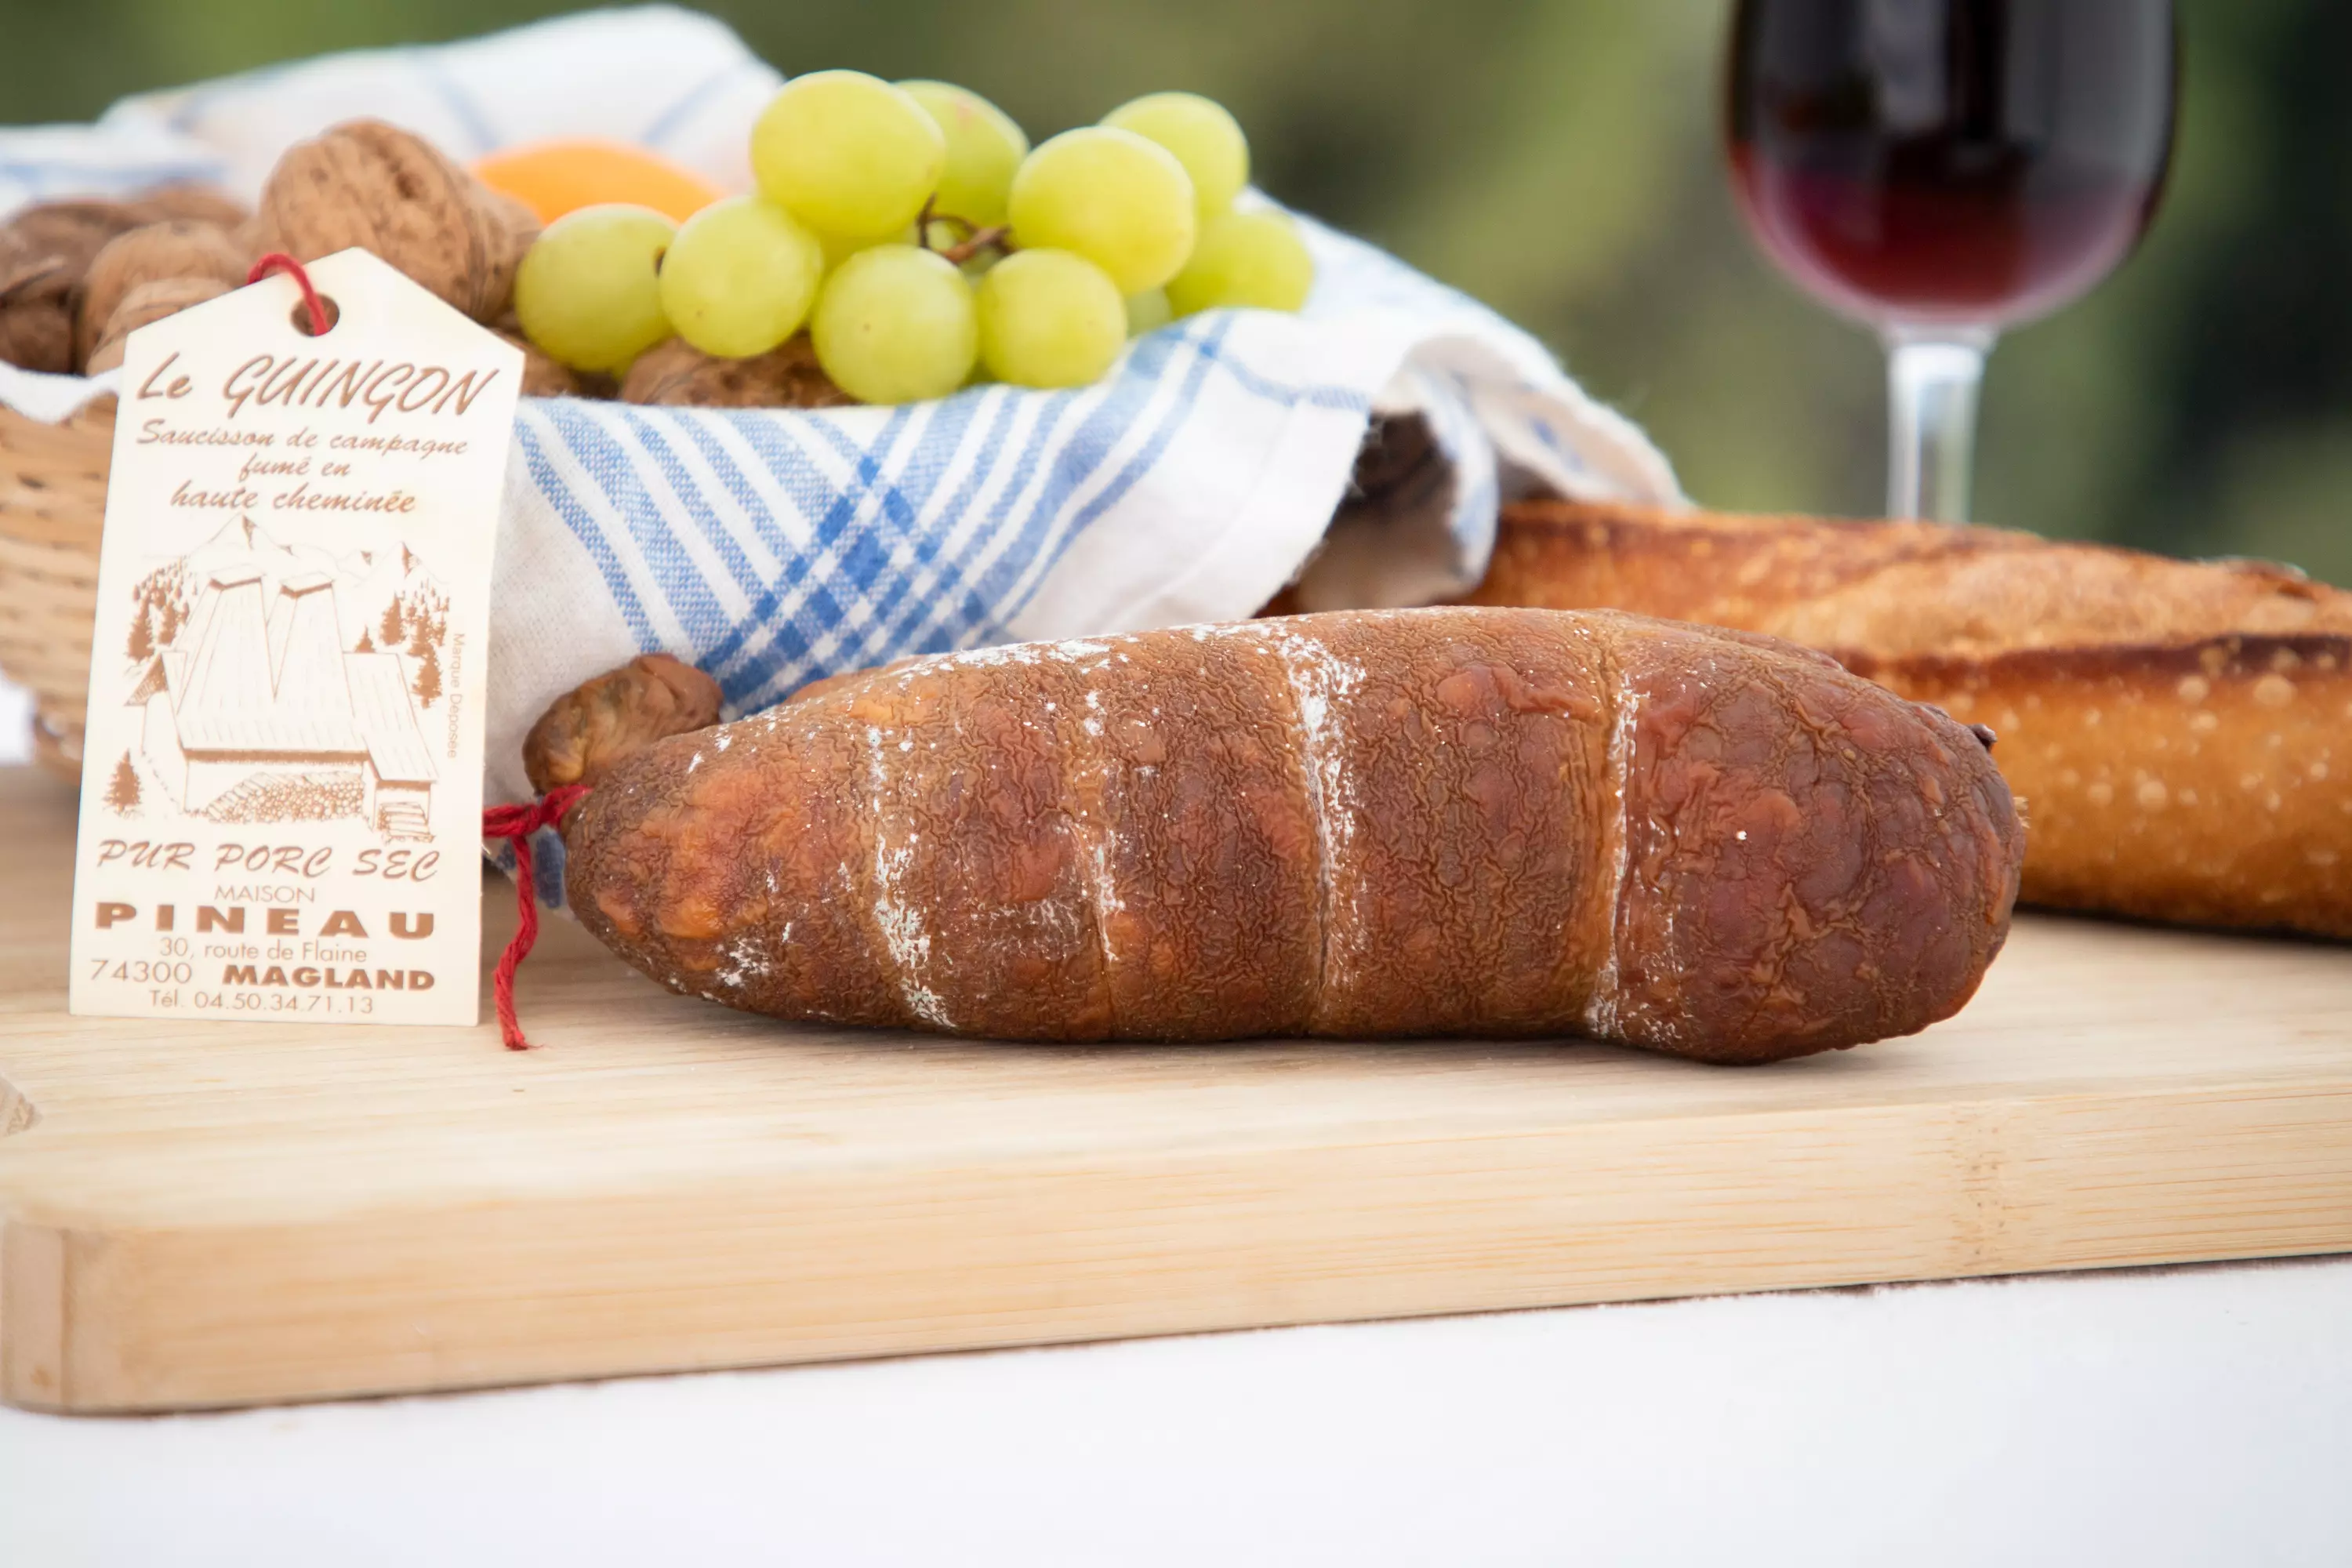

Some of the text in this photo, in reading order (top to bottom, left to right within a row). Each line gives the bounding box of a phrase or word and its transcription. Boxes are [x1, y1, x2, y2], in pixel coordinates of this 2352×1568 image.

[136, 351, 193, 401] Le
[136, 419, 468, 461] Saucisson de campagne
[238, 452, 351, 483] fumé en
[169, 480, 416, 514] haute cheminée
[450, 633, 466, 688] Marque
[96, 839, 441, 883] PUR PORC SEC
[213, 884, 316, 903] MAISON
[95, 901, 434, 941] PINEAU
[159, 936, 368, 964] 30, route de Flaine
[90, 959, 435, 991] 74300 MAGLAND
[150, 989, 374, 1014] Tél. 04.50.34.71.13
